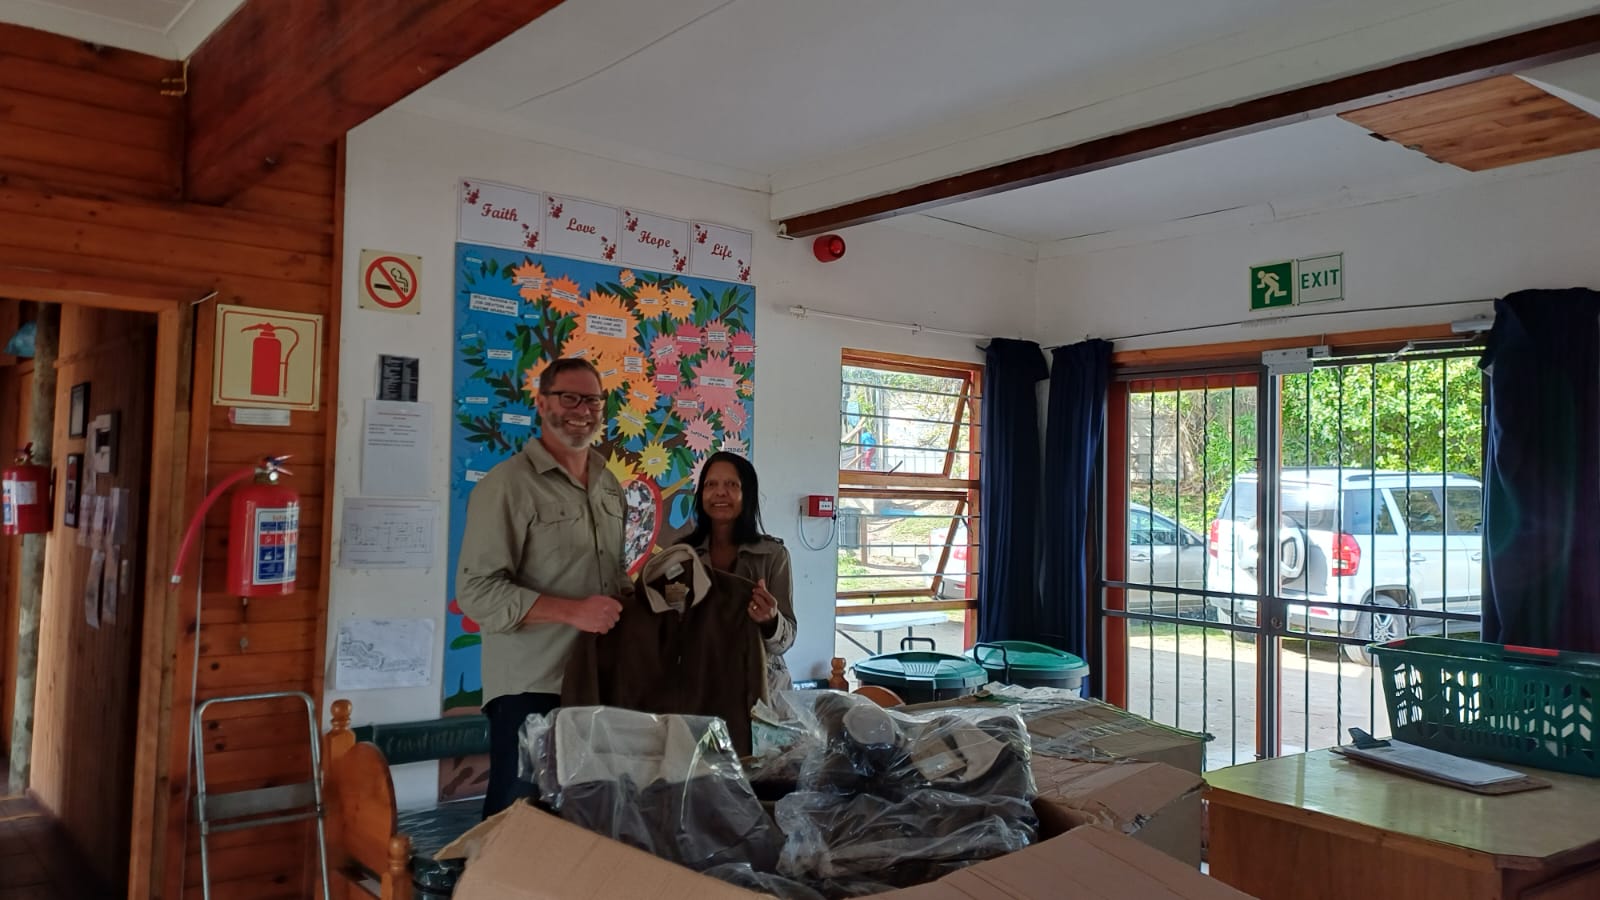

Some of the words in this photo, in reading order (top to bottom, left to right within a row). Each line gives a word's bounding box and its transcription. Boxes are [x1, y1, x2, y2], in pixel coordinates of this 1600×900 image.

[481, 203, 519, 222] Faith
[566, 217, 597, 235] Love
[638, 230, 672, 248] Hope
[711, 243, 732, 260] Life
[1301, 269, 1340, 289] EXIT
